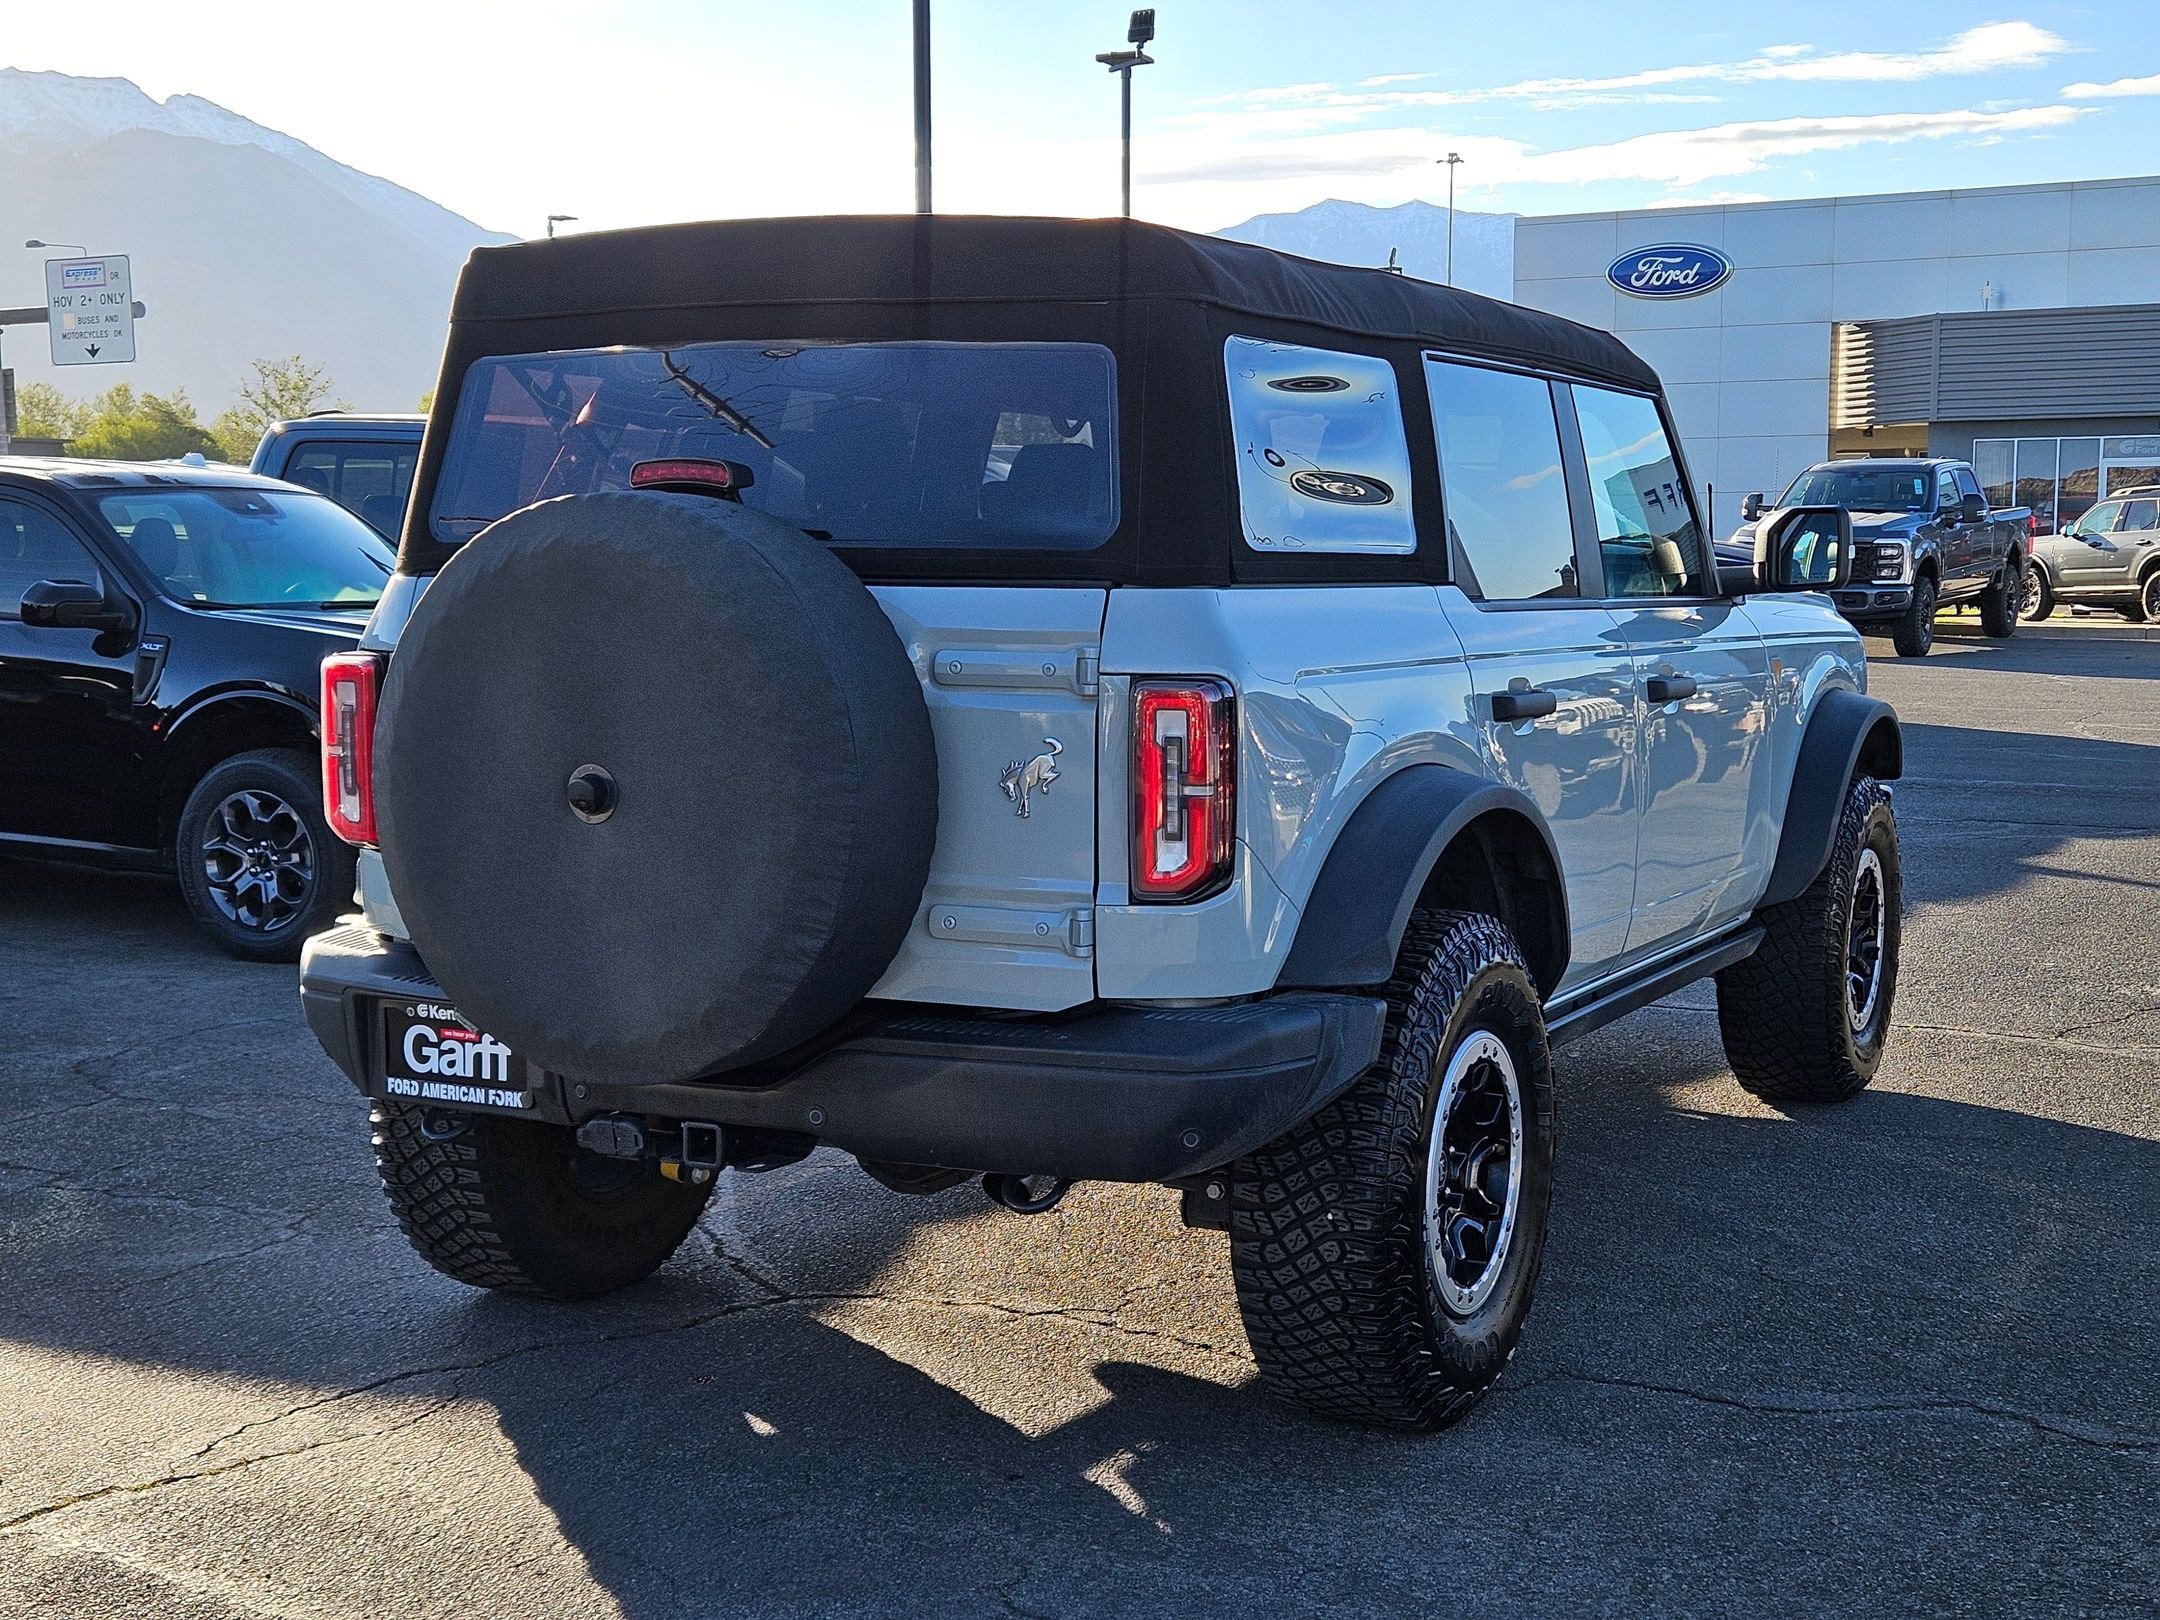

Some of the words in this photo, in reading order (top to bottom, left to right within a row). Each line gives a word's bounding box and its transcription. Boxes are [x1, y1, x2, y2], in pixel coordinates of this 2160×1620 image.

[65, 268, 98, 279] Express
[109, 271, 119, 280] OR
[1630, 256, 1701, 287] Ford
[53, 295, 73, 308] HOV
[80, 295, 93, 306] 2+
[99, 292, 125, 305] ONLY
[77, 316, 100, 325] BUSES
[104, 314, 119, 323] AND
[61, 329, 109, 340] MOTORCYCLES
[113, 330, 123, 338] OK
[2135, 446, 2158, 454] Ford
[140, 642, 164, 651] XLT
[387, 1077, 419, 1096] FORD
[421, 1082, 486, 1104] AMERICAN
[488, 1089, 524, 1108] FORK
